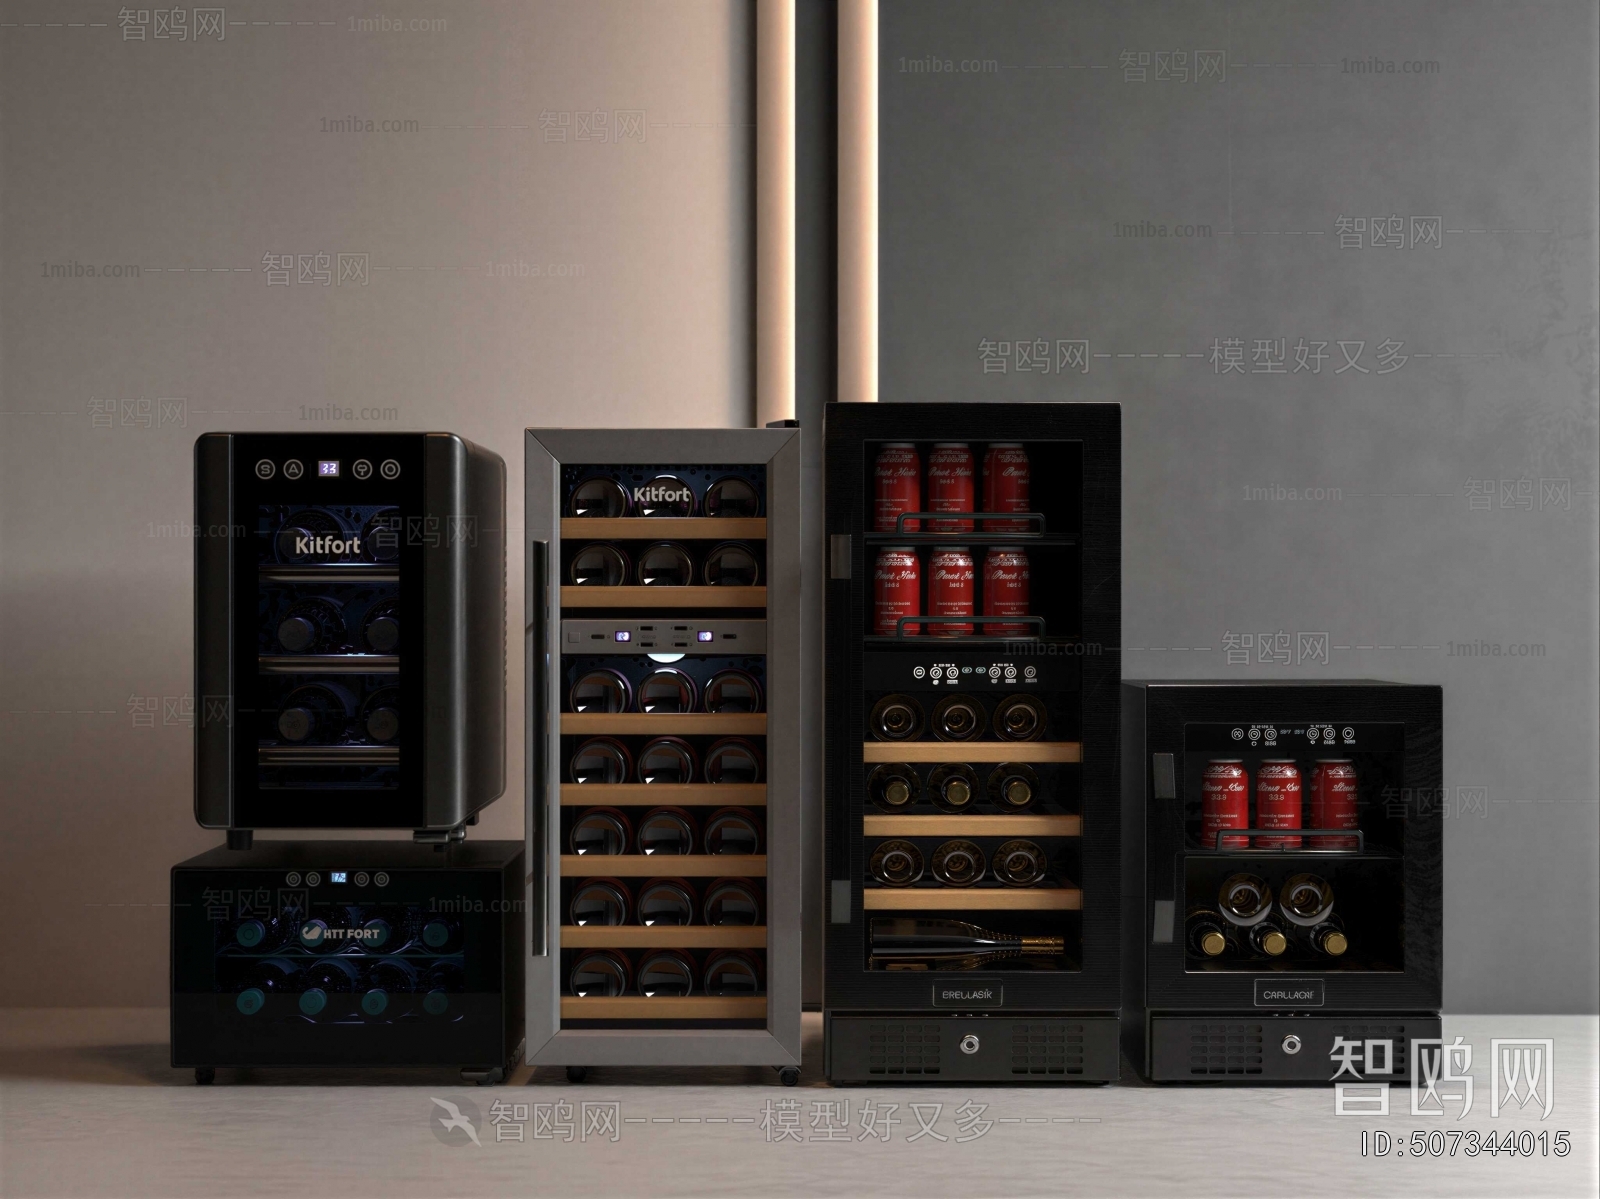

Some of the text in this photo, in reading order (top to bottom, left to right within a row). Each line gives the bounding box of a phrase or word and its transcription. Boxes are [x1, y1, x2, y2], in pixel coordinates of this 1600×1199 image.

[633, 486, 690, 503] Kitfort
[295, 535, 361, 554] Kitfort
[347, 929, 380, 939] FORT
